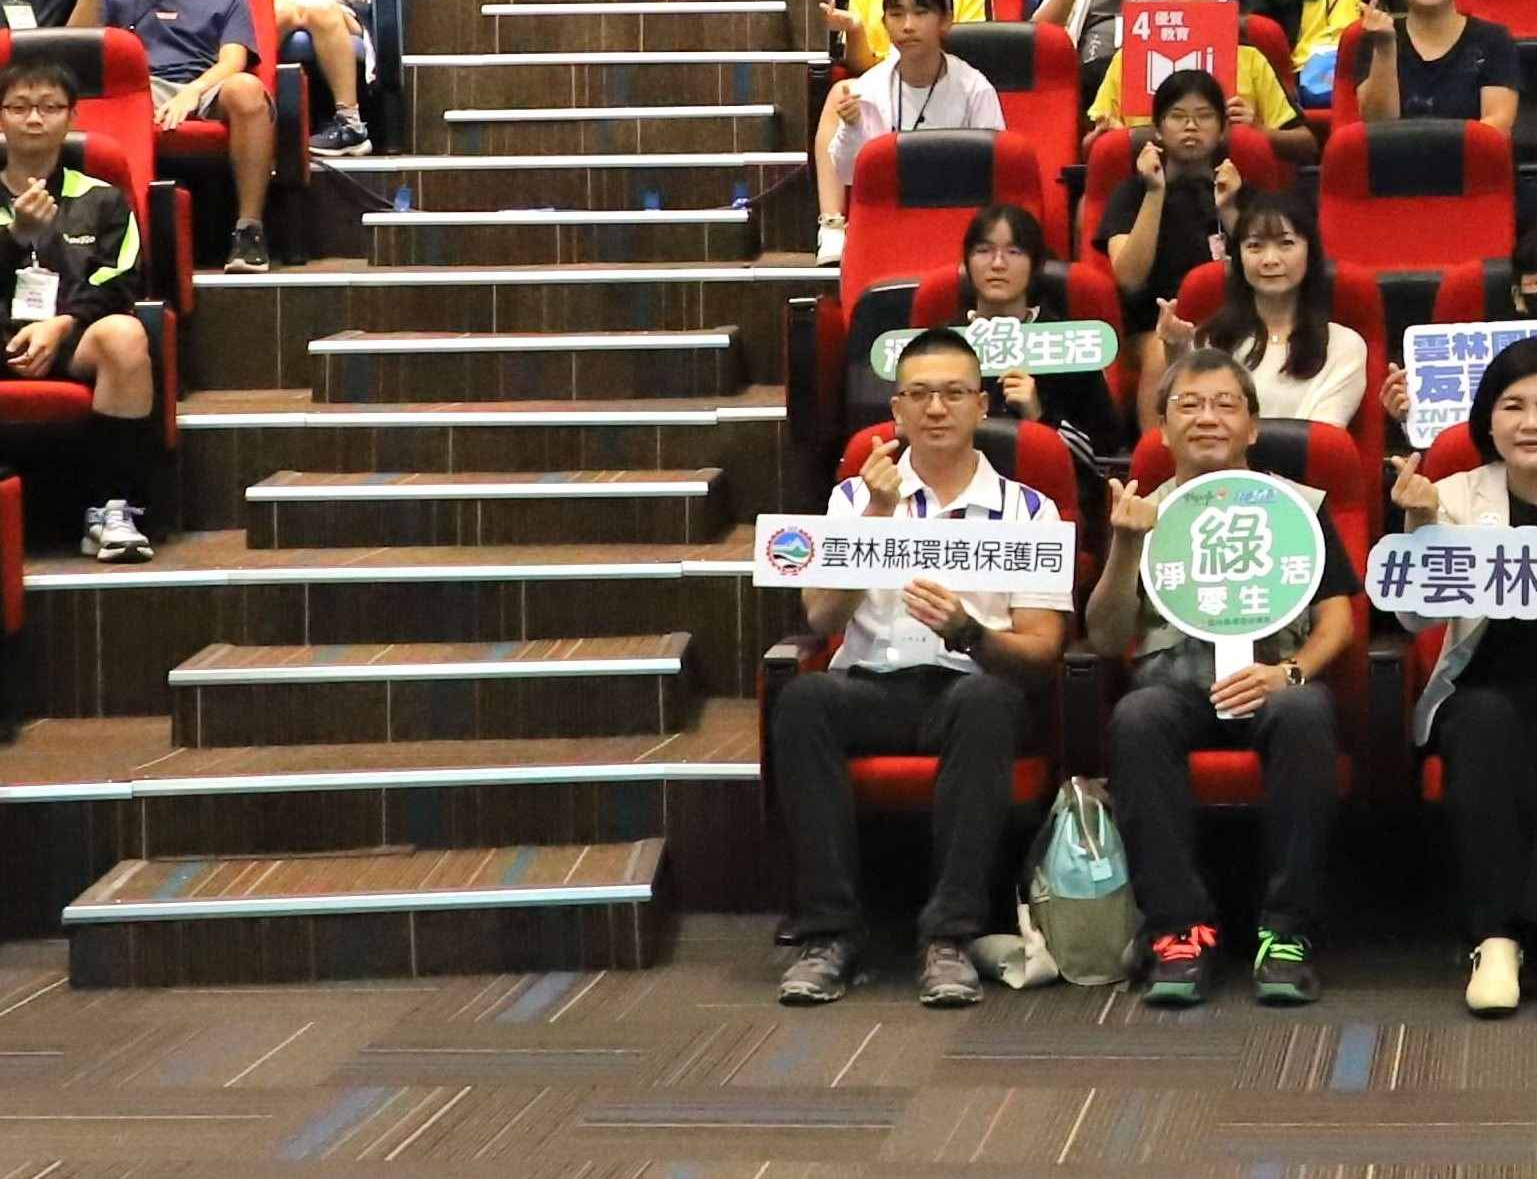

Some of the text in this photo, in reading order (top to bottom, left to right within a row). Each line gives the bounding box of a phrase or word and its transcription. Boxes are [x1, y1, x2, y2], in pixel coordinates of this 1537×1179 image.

[1132, 11, 1151, 41] 4
[820, 536, 1064, 574] 雲林縣環境保護局
